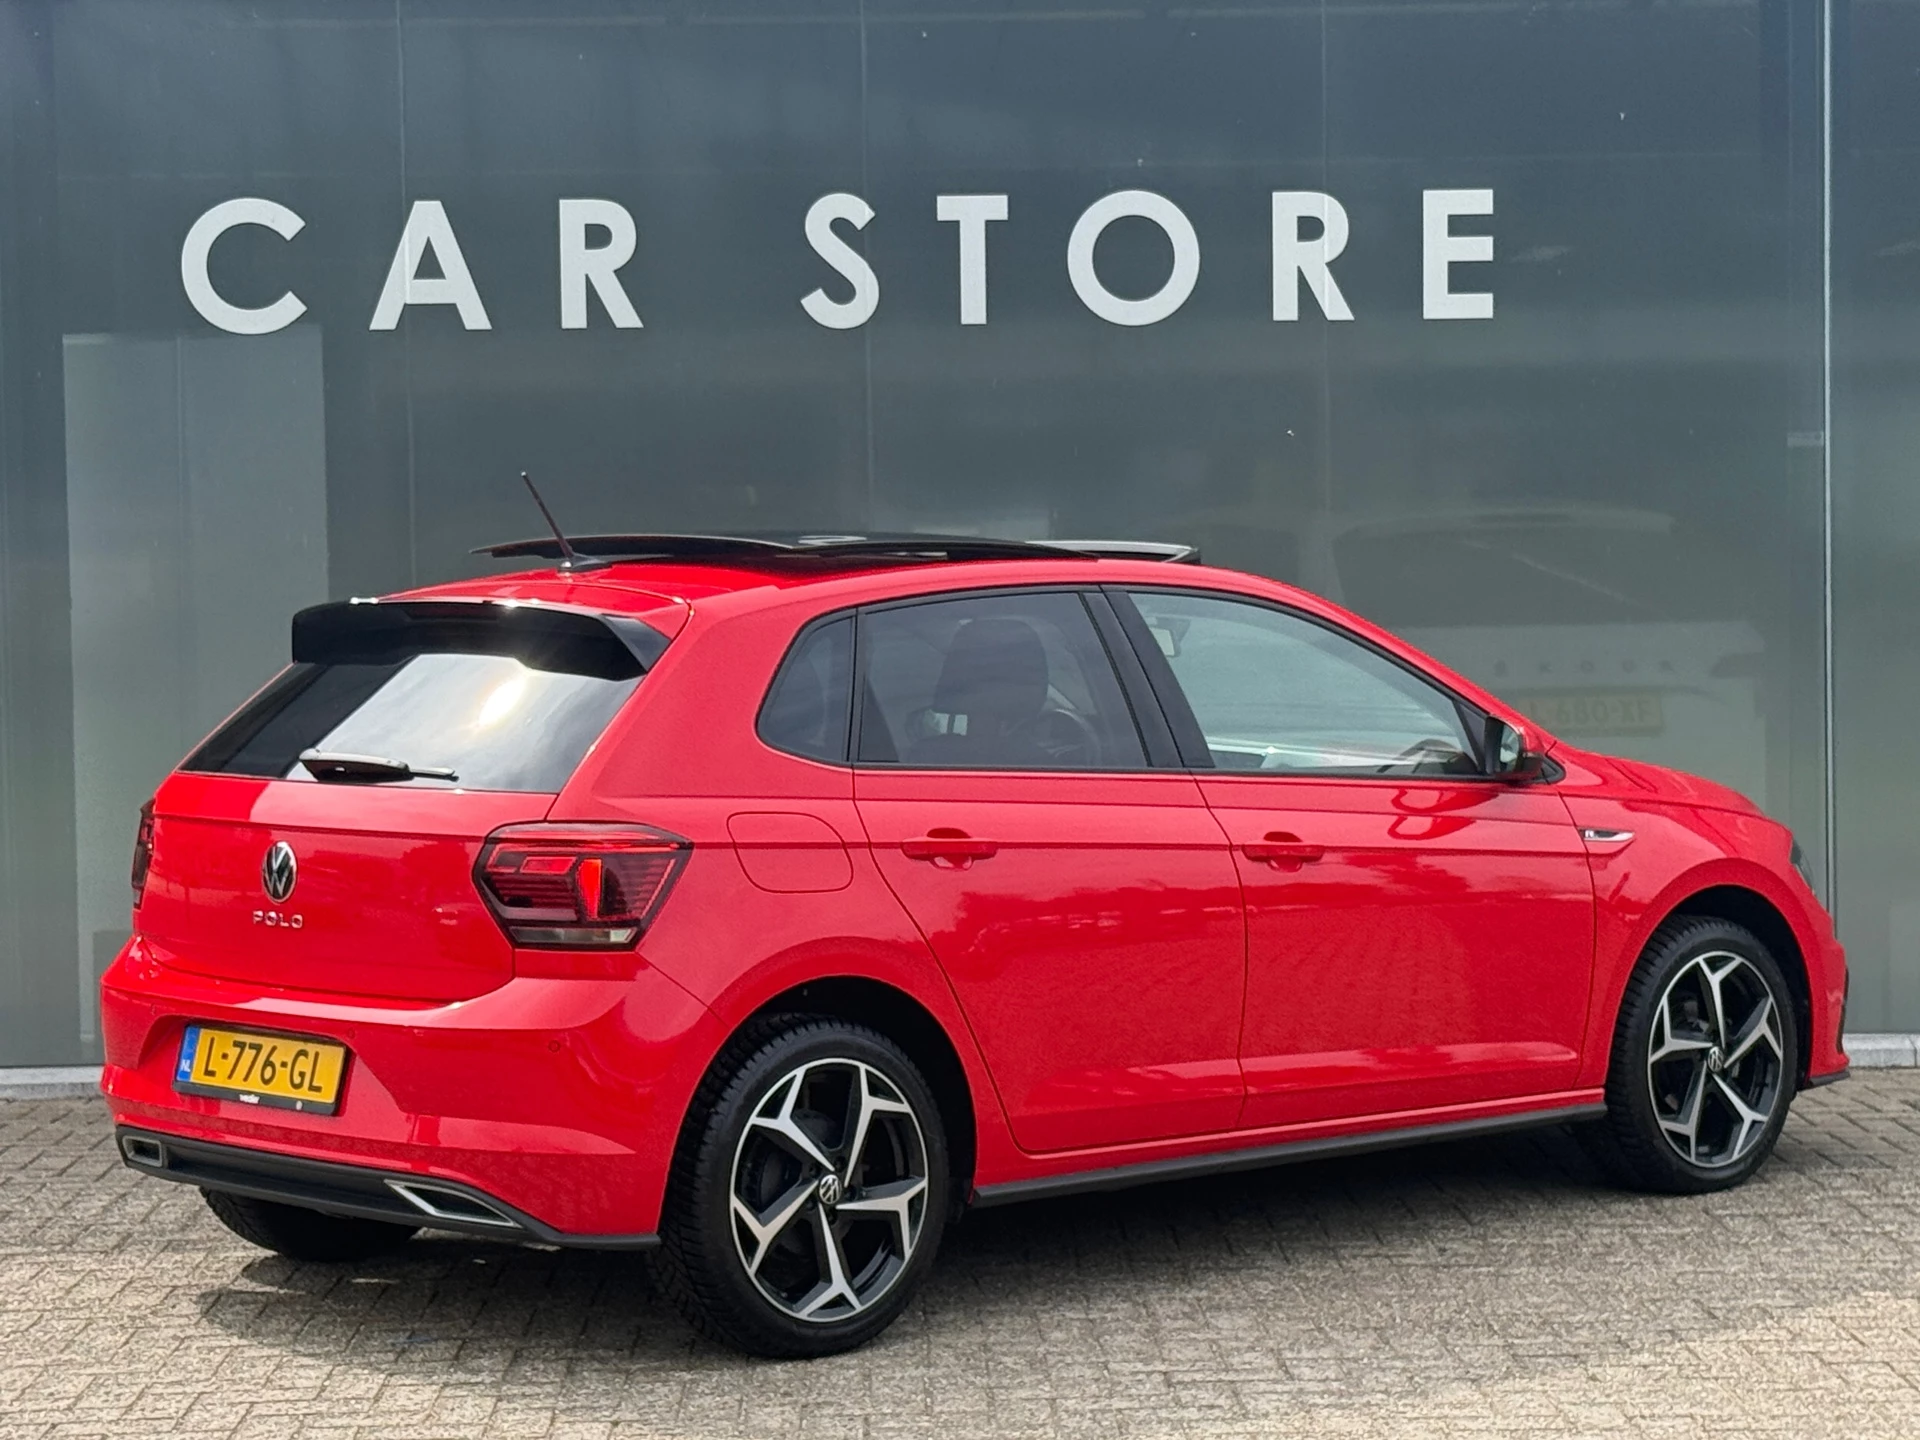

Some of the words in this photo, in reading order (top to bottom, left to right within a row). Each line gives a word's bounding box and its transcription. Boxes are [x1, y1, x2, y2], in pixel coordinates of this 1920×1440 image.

[181, 198, 643, 335] CAR
[801, 189, 1495, 330] STORE
[252, 910, 303, 929] POLO
[180, 1059, 191, 1073] NL
[203, 1036, 323, 1093] L-776-GL
